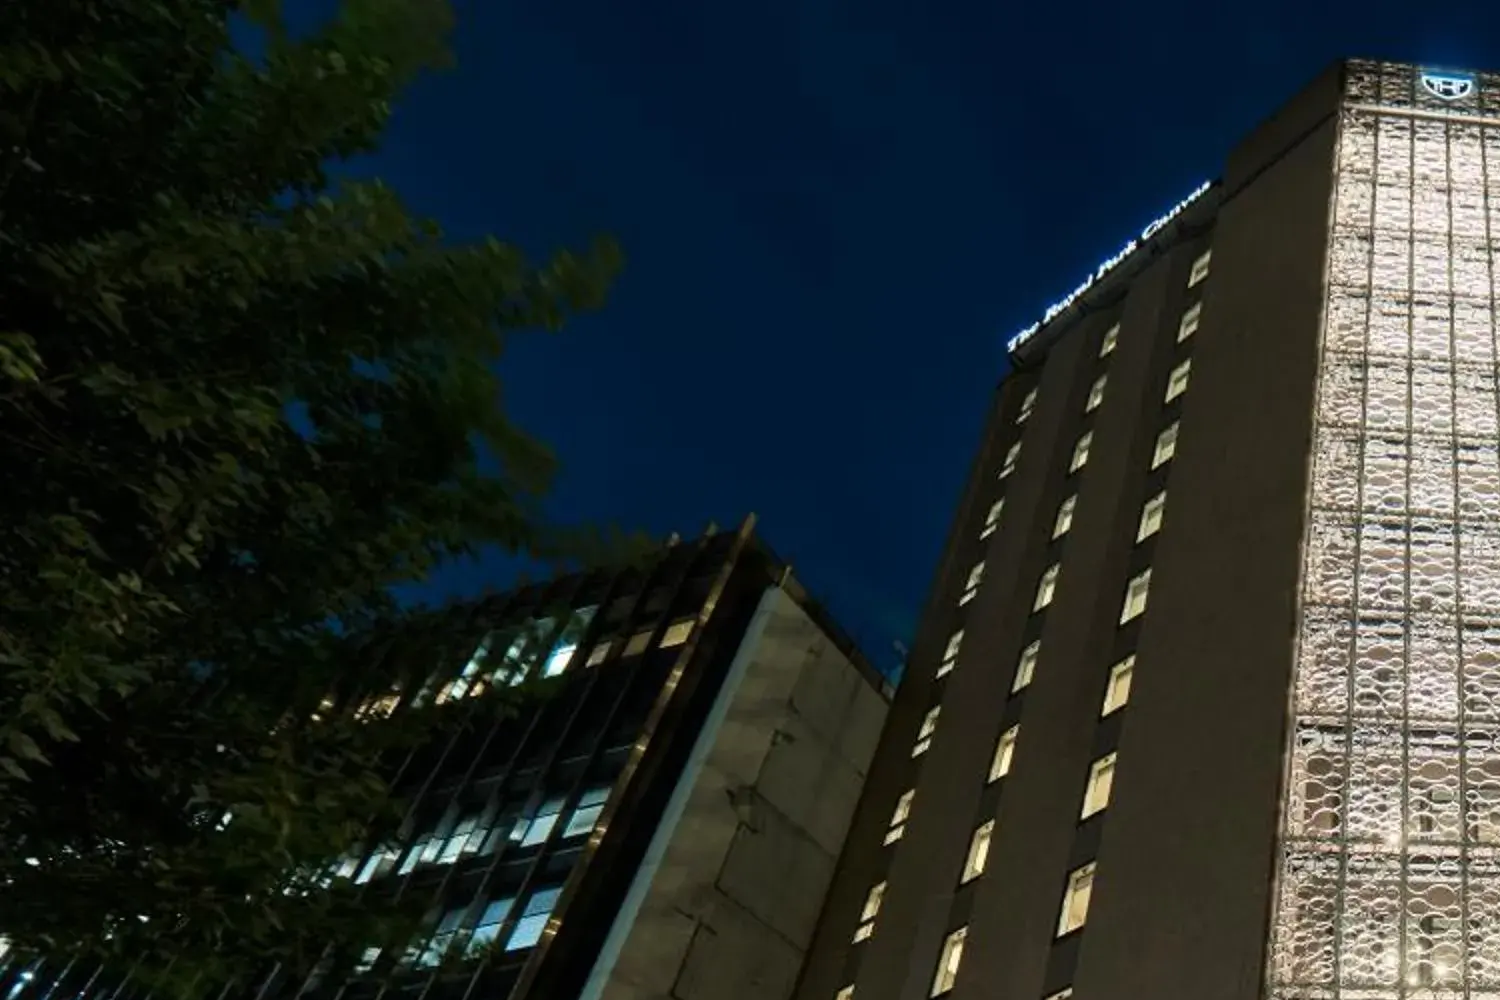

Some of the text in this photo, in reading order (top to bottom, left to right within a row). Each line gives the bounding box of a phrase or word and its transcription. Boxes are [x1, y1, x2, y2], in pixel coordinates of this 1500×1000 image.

[1007, 180, 1211, 352] The Royal Park Canvas
